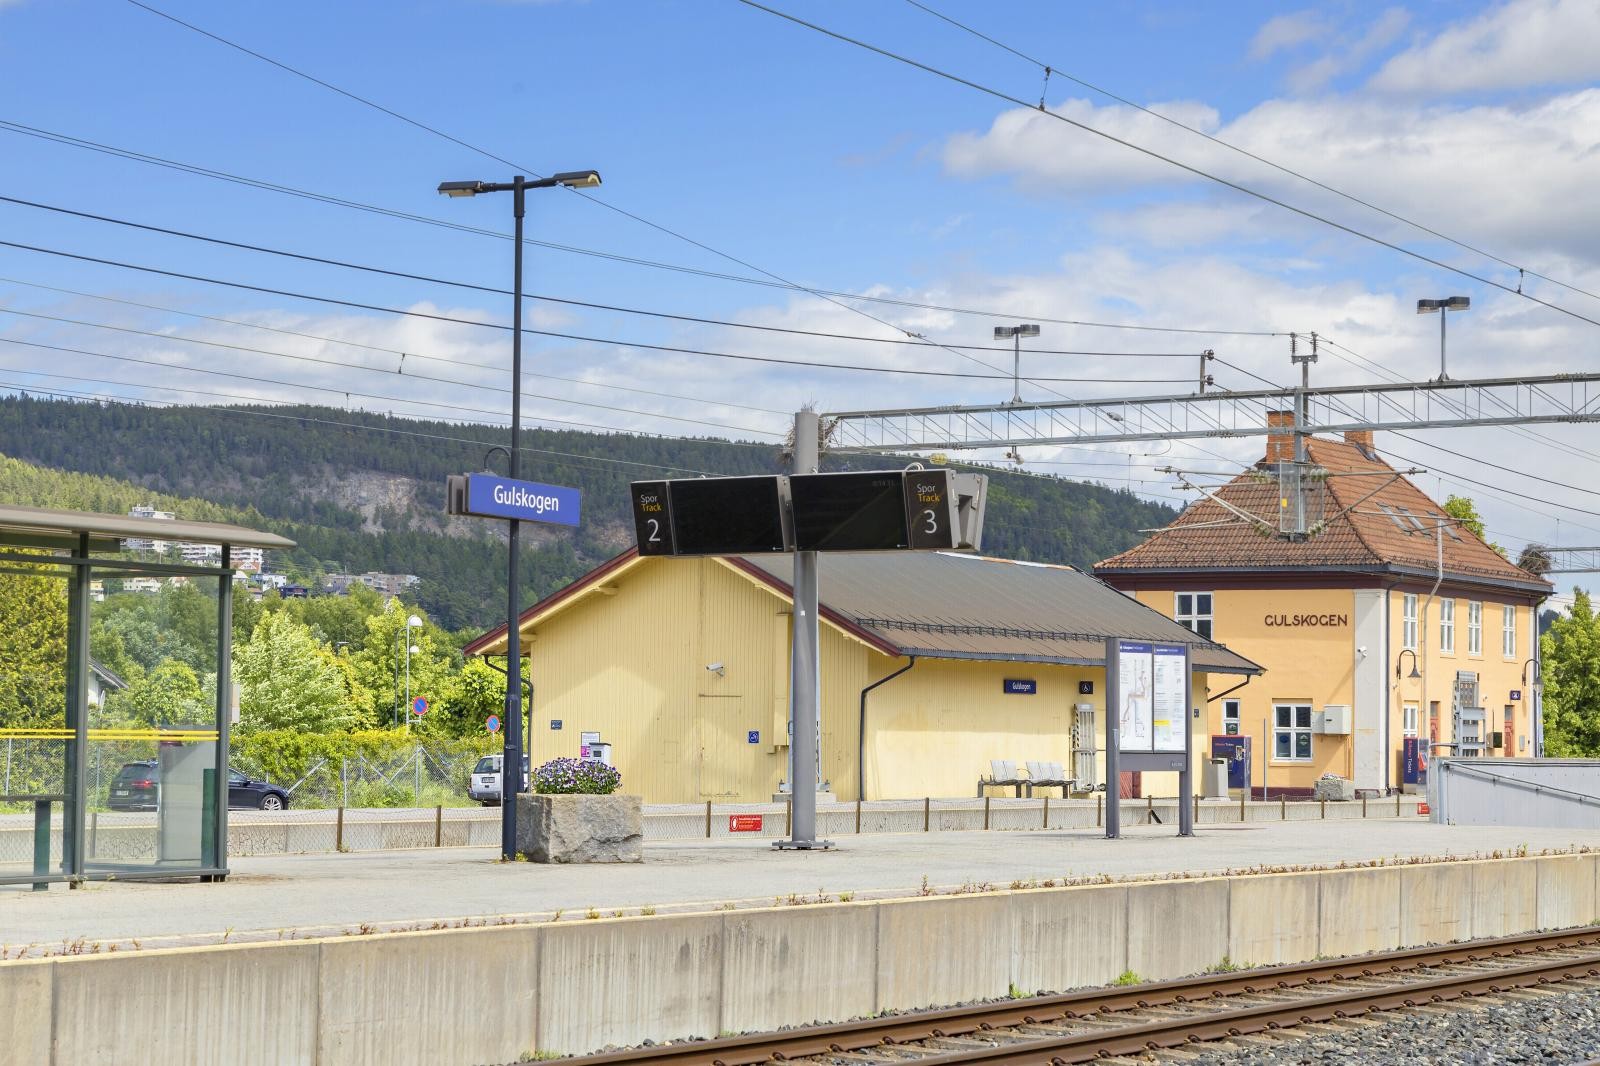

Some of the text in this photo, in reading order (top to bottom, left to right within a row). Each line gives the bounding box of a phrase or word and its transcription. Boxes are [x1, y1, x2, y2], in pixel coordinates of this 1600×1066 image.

[917, 484, 936, 494] Spor
[494, 485, 559, 514] Gulskogen
[640, 494, 658, 504] Spor
[918, 493, 941, 503] Track
[641, 503, 662, 512] Track
[923, 509, 938, 534] 3
[647, 518, 661, 542] 2
[1264, 614, 1348, 627] GULSKOGEN
